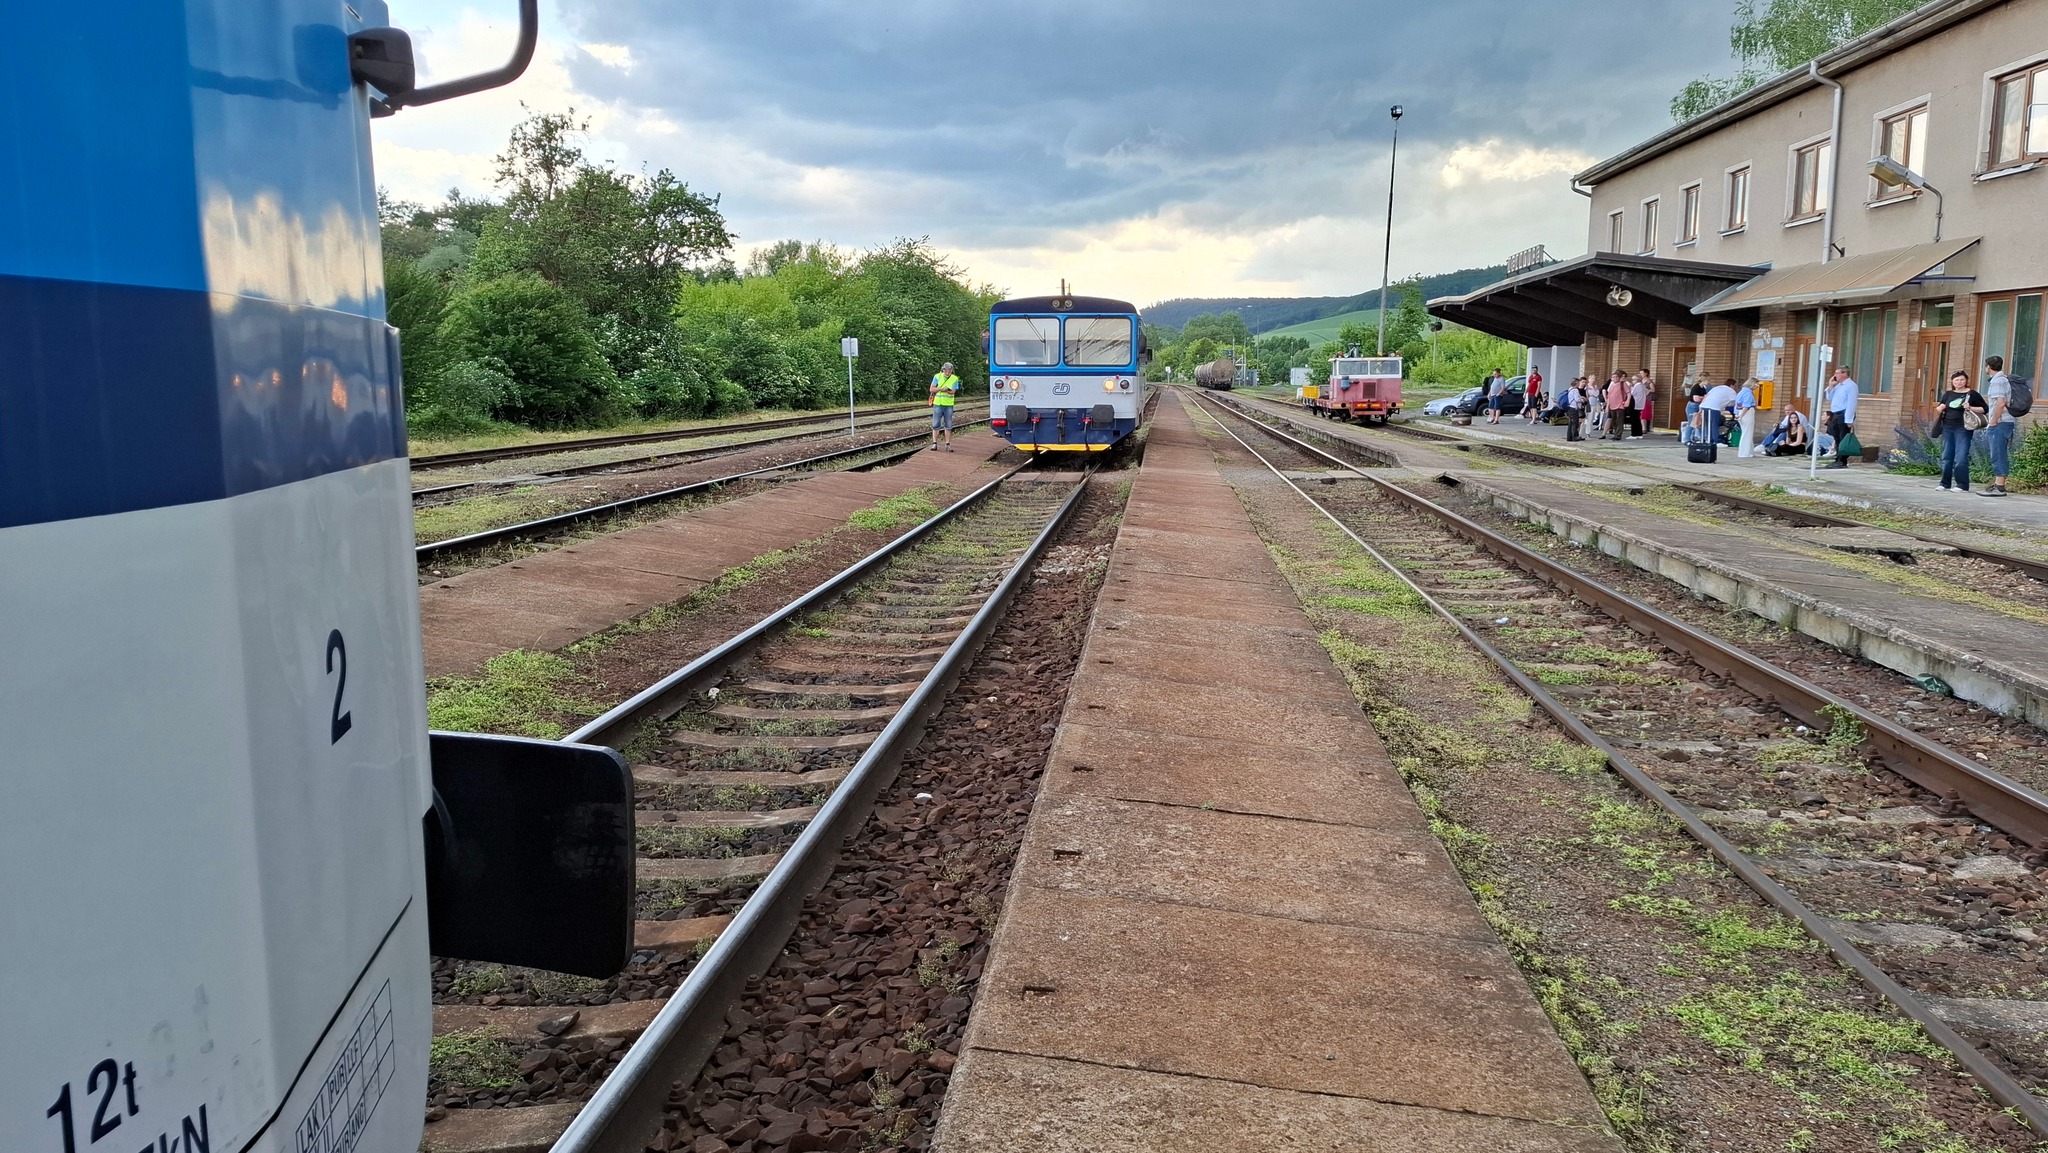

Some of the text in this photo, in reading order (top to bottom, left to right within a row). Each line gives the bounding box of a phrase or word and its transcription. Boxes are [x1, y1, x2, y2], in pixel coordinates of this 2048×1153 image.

[326, 628, 352, 746] 2
[46, 1058, 139, 1153] 12t
[329, 1063, 346, 1105] PUR
